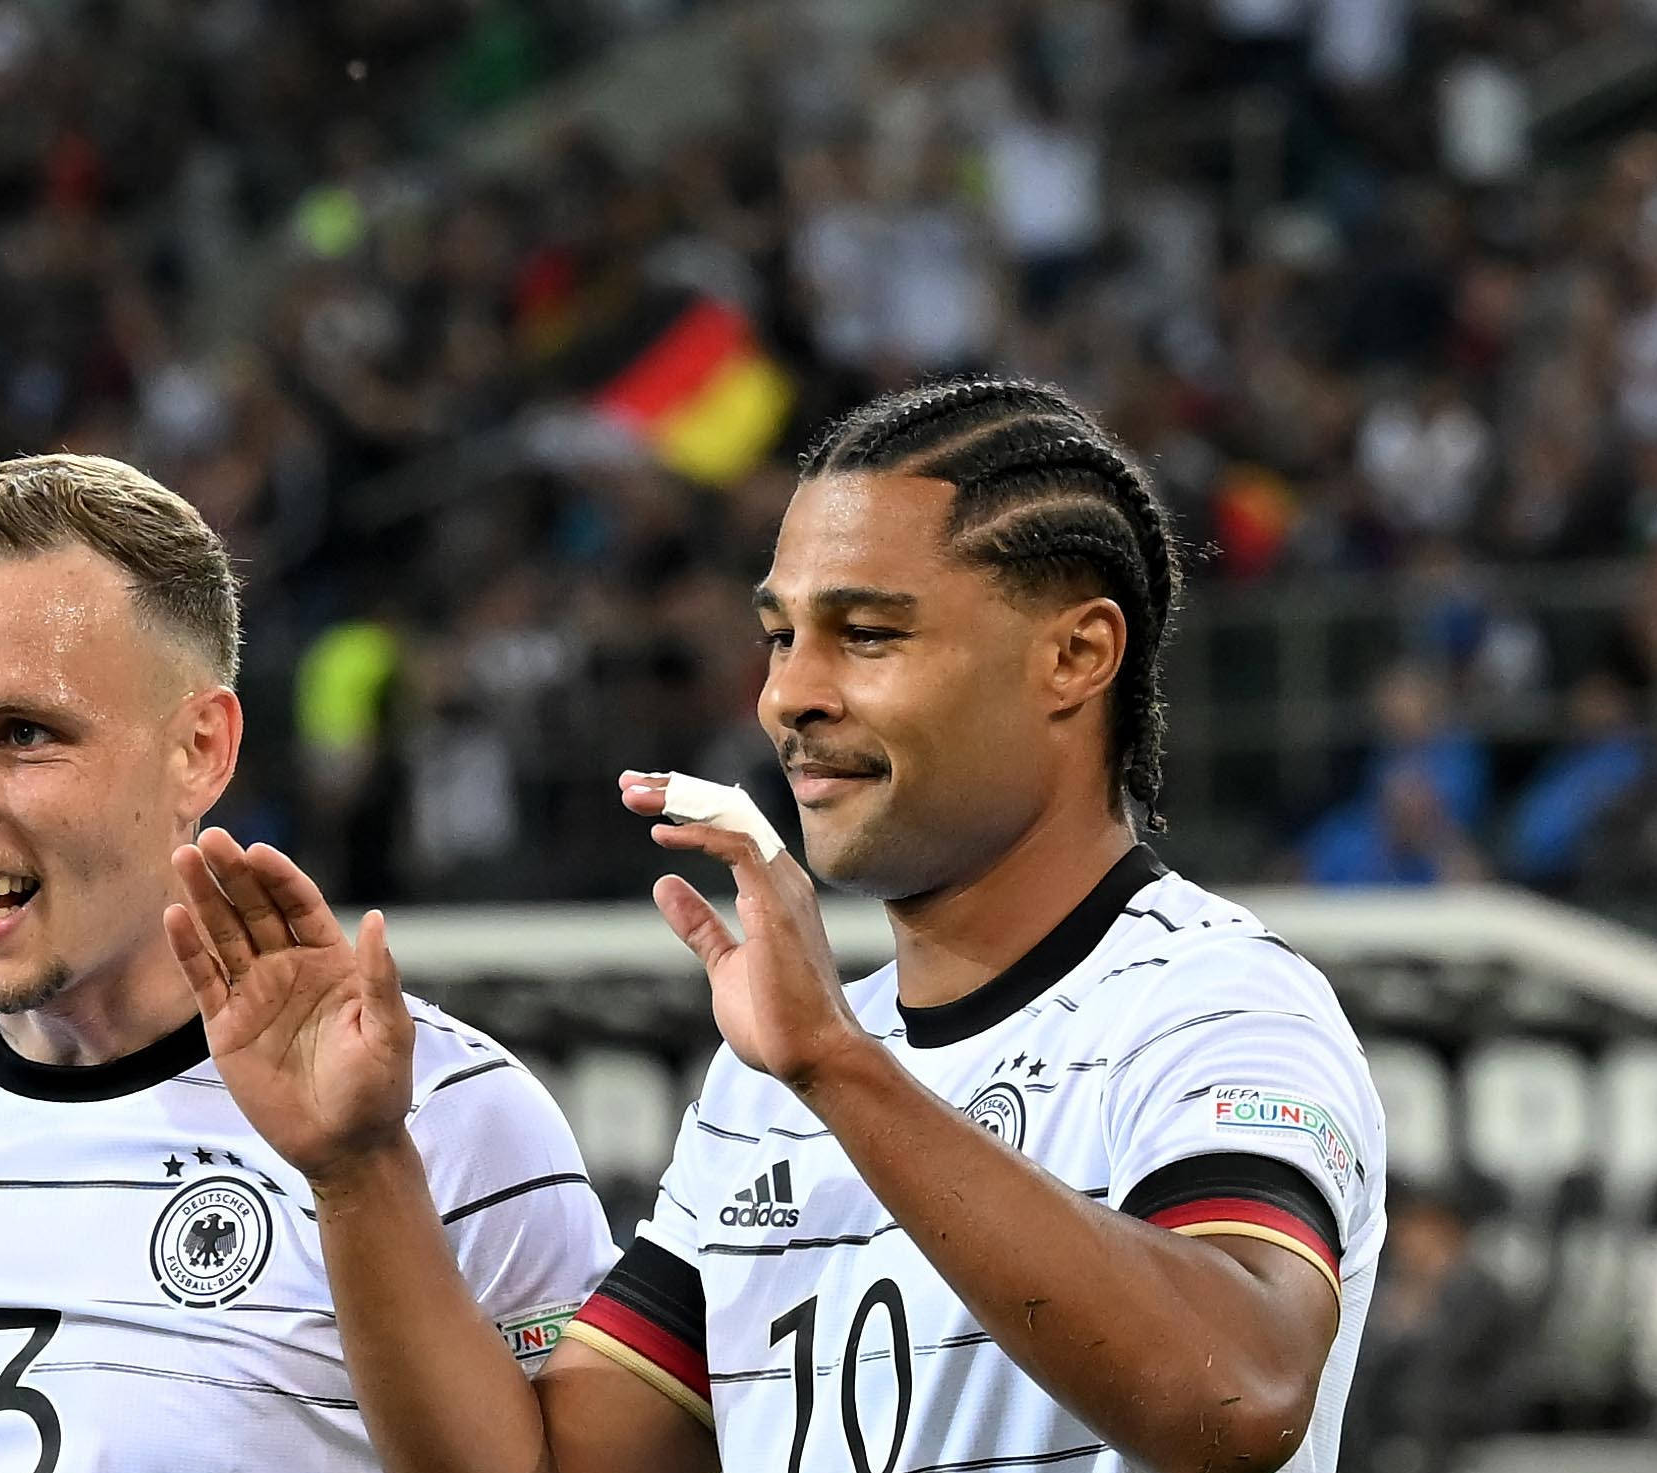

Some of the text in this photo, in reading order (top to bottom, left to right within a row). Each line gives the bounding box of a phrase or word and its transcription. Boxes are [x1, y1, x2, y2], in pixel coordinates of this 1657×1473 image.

[1216, 1088, 1260, 1100] UEFA
[181, 1192, 251, 1218] DEUTSCHER
[718, 1200, 801, 1229] adidas
[166, 1255, 249, 1291] FUSSBALL-BUND
